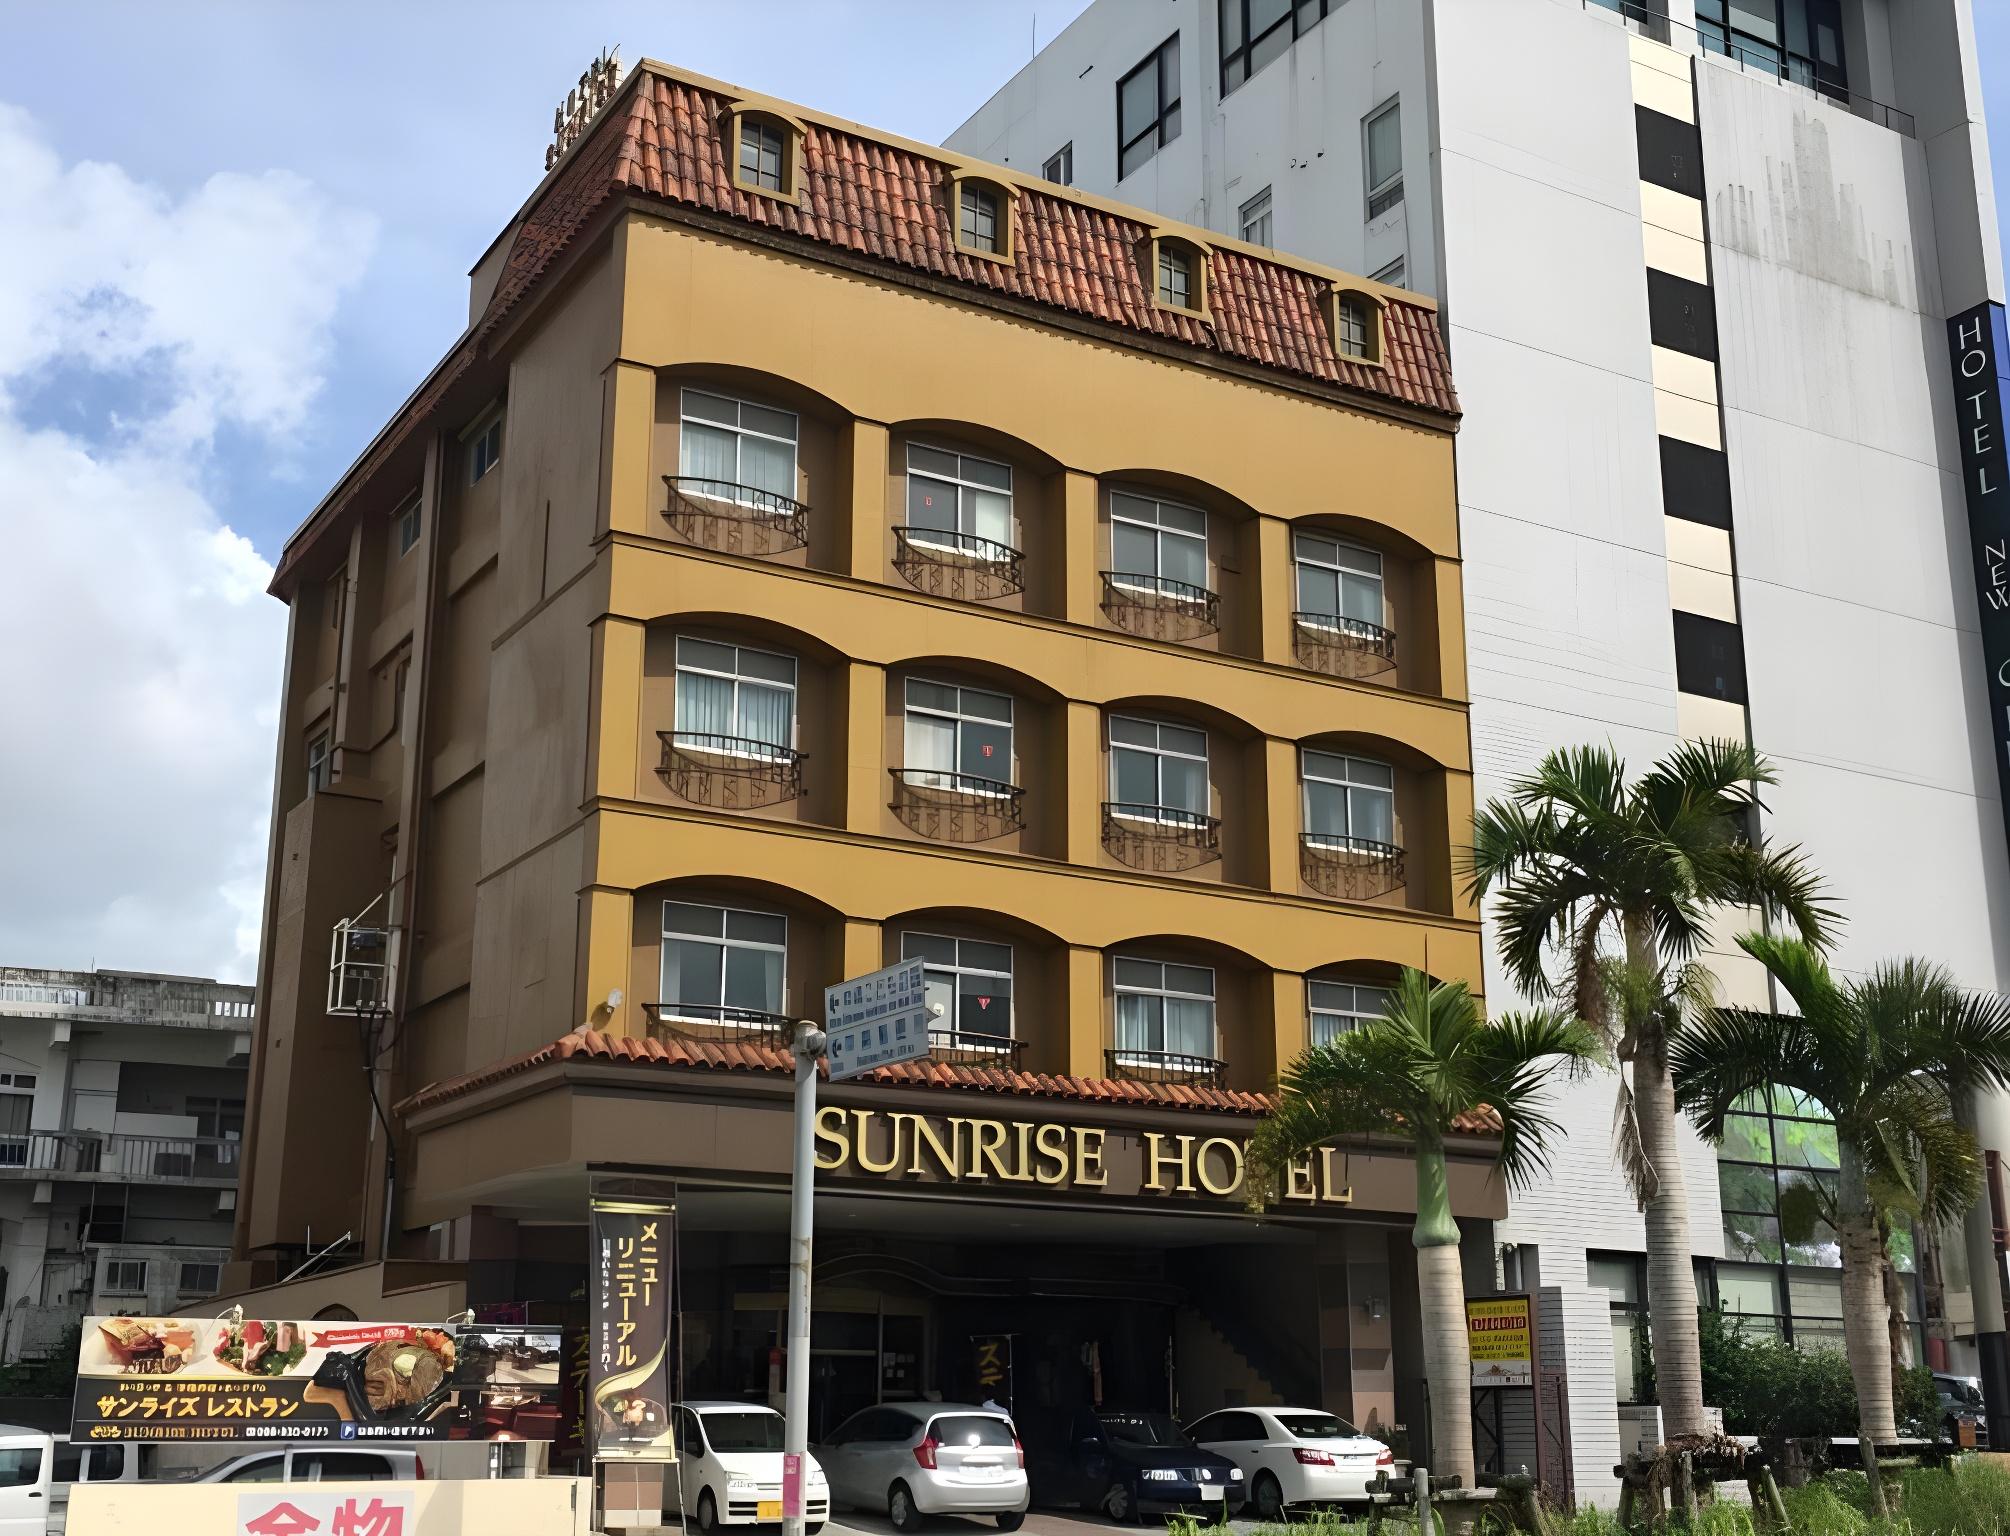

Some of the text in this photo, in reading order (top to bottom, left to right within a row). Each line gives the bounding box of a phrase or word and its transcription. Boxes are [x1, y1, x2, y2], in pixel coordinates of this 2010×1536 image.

[1958, 316, 1998, 496] HOTEL
[814, 1105, 1353, 1203] SUNRISE HOEL
[616, 1236, 638, 1367] リニューアル
[640, 1221, 659, 1307] メニュー
[96, 1395, 299, 1418] サンライズ レストラン
